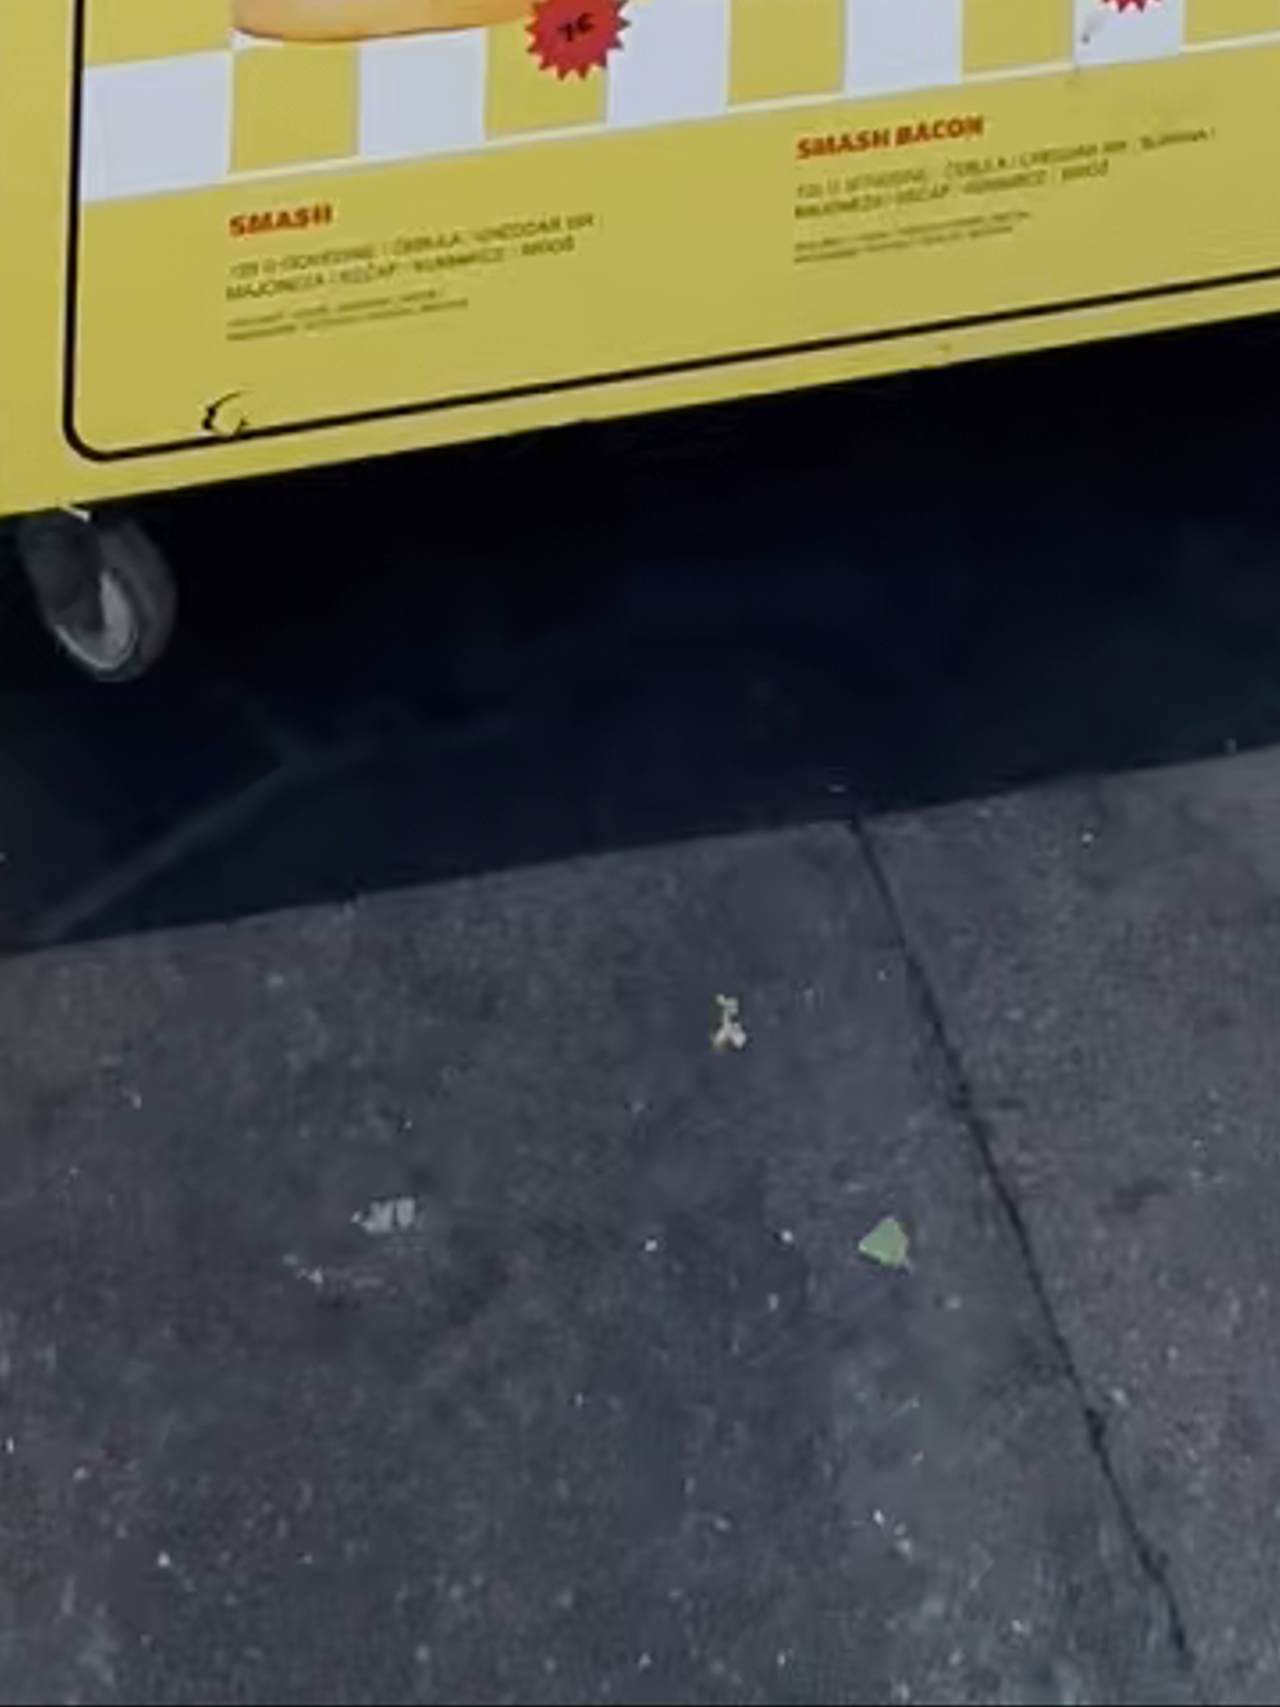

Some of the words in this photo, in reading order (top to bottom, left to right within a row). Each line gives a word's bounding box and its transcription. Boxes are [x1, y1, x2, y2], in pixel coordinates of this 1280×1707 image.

[795, 128, 890, 160] SMASH
[895, 115, 985, 146] BACON
[229, 203, 334, 237] SMASH
